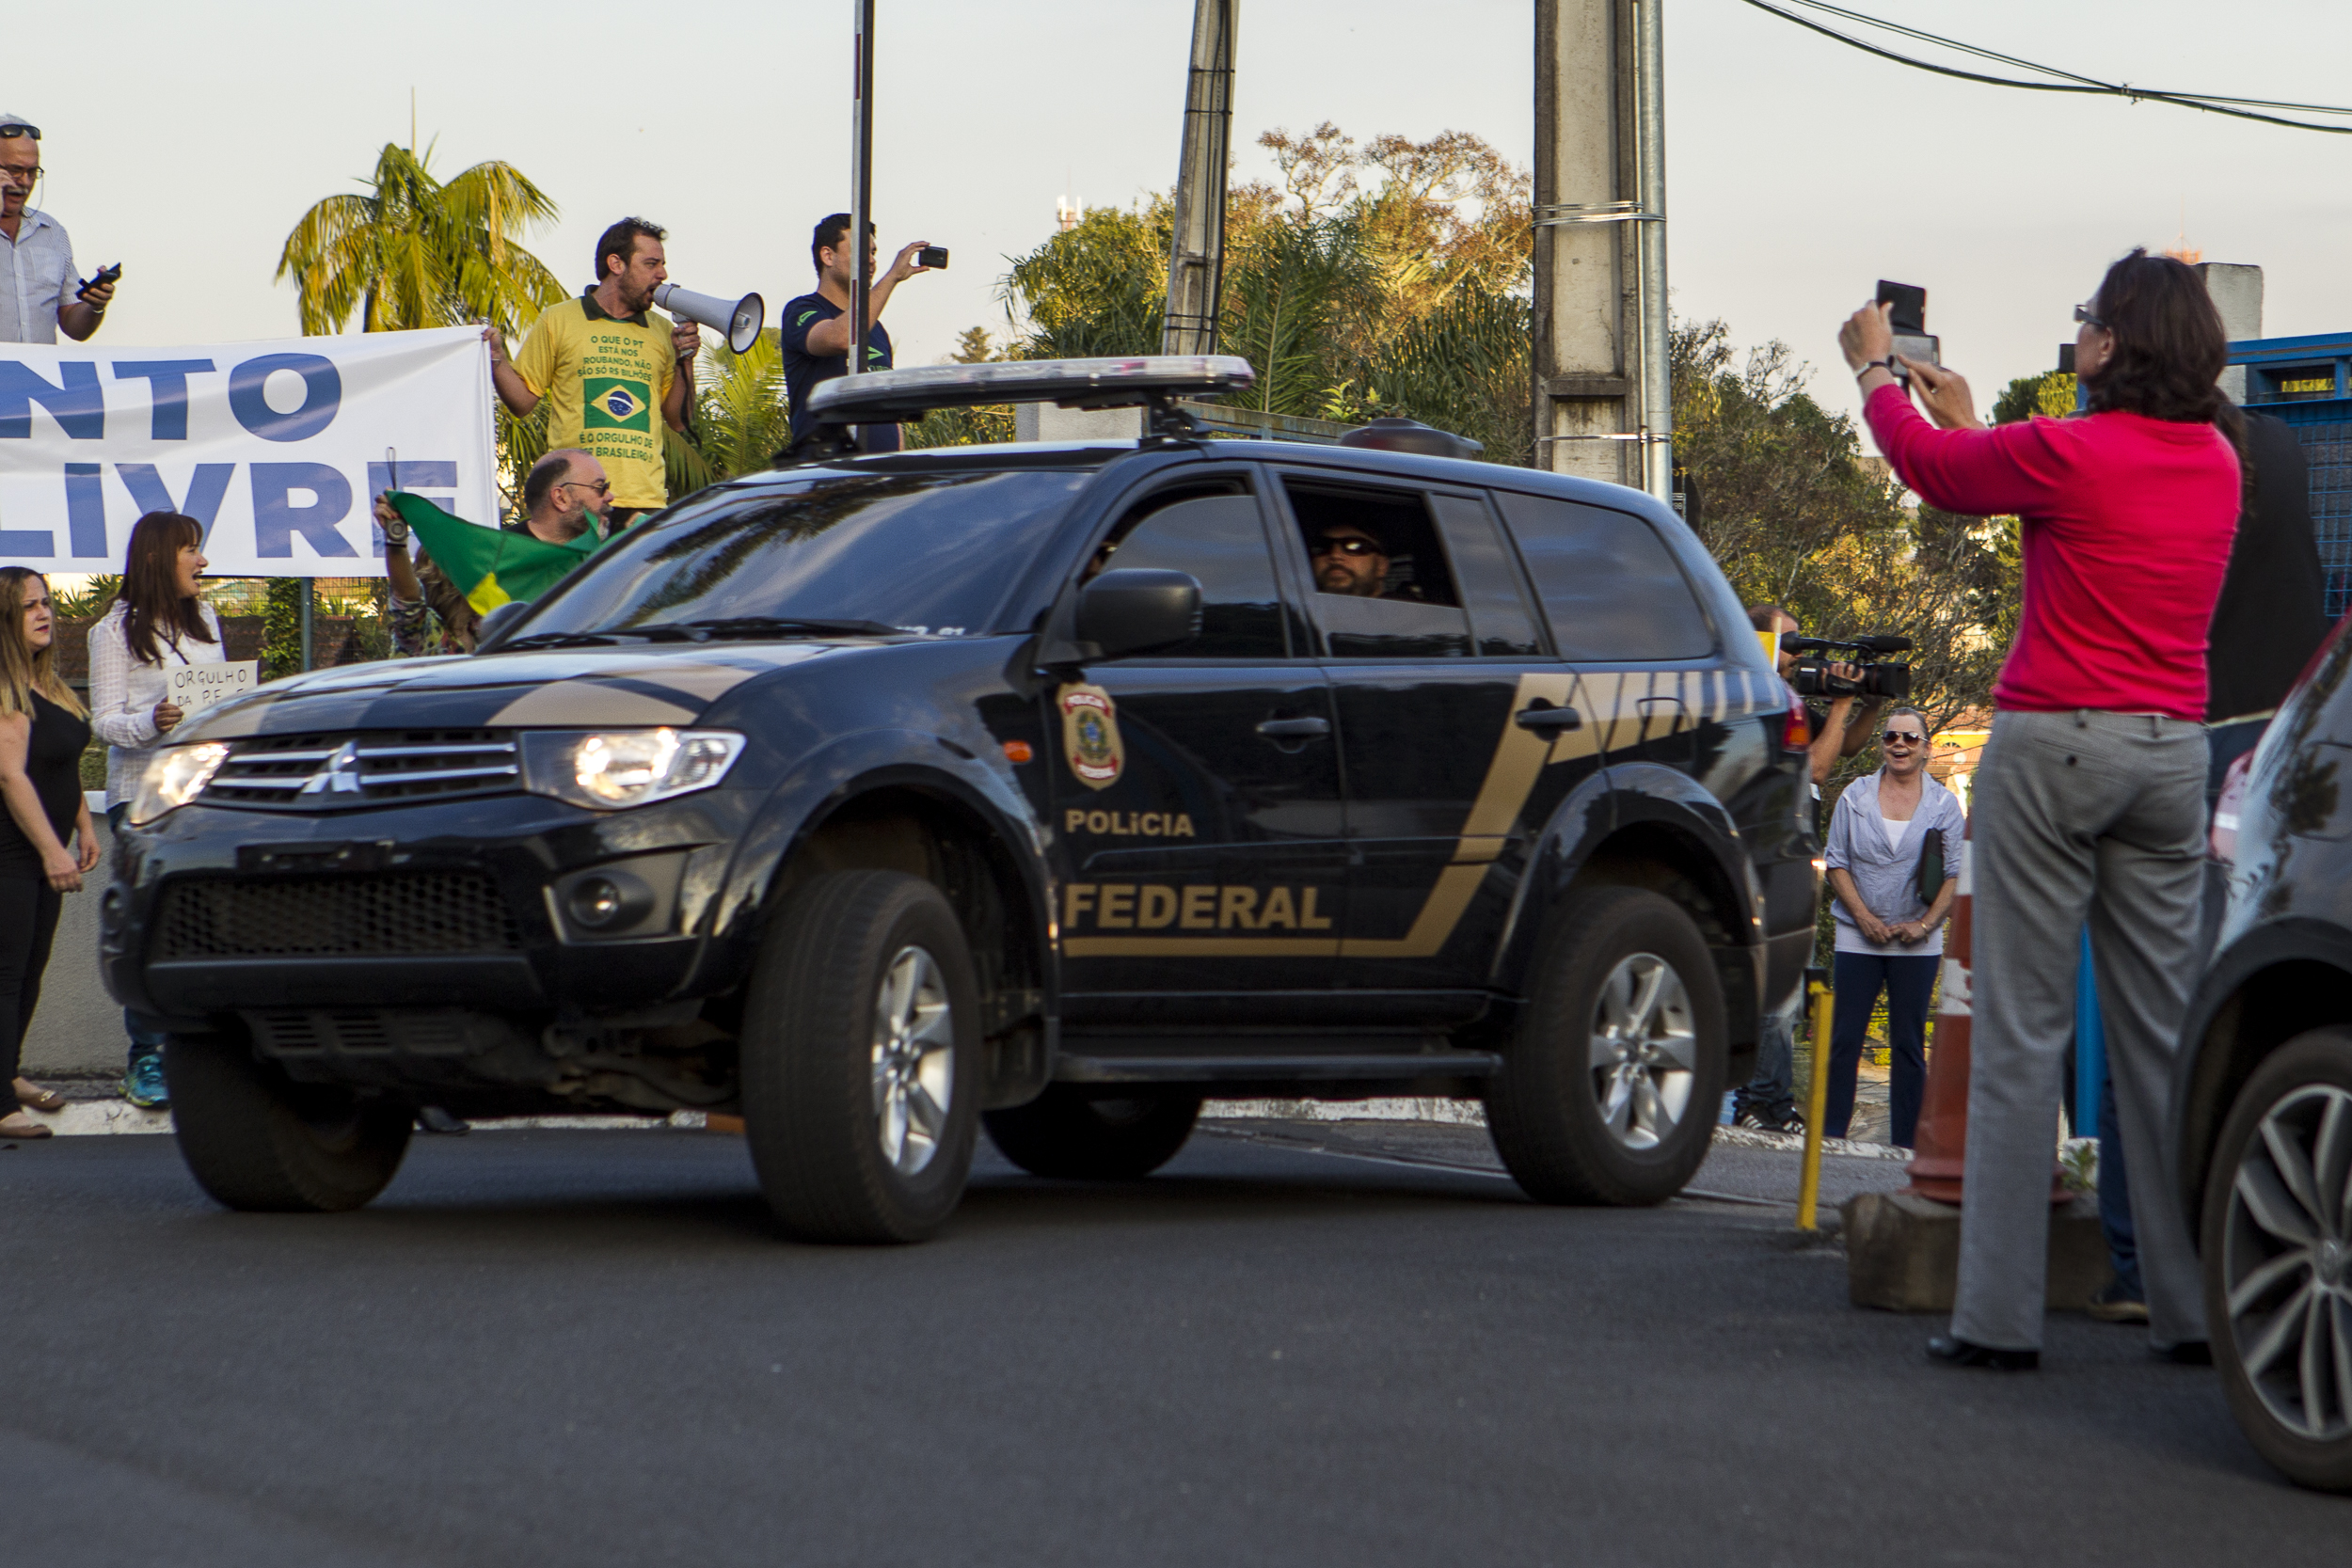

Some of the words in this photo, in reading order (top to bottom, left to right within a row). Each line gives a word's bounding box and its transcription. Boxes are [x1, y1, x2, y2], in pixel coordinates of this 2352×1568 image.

[591, 335, 598, 343] O
[601, 336, 621, 345] QUE
[623, 337, 630, 346] O
[632, 340, 644, 349] PT
[598, 345, 619, 355] ESTÁ
[621, 348, 638, 357] NOS
[583, 356, 633, 368] ROUBANDO,
[634, 358, 652, 371] NÃO
[577, 366, 594, 377] SÃO
[596, 365, 608, 375] SÓ
[621, 369, 652, 382] BILHÕES
[580, 432, 585, 444] É
[587, 433, 595, 443] O
[596, 433, 644, 446] ORGULHO
[644, 437, 653, 449] DE
[175, 669, 247, 689] ORGULHO
[177, 695, 192, 707] DA
[1065, 809, 1196, 837] POLÍCIA
[1063, 883, 1333, 929] FEDERAL
